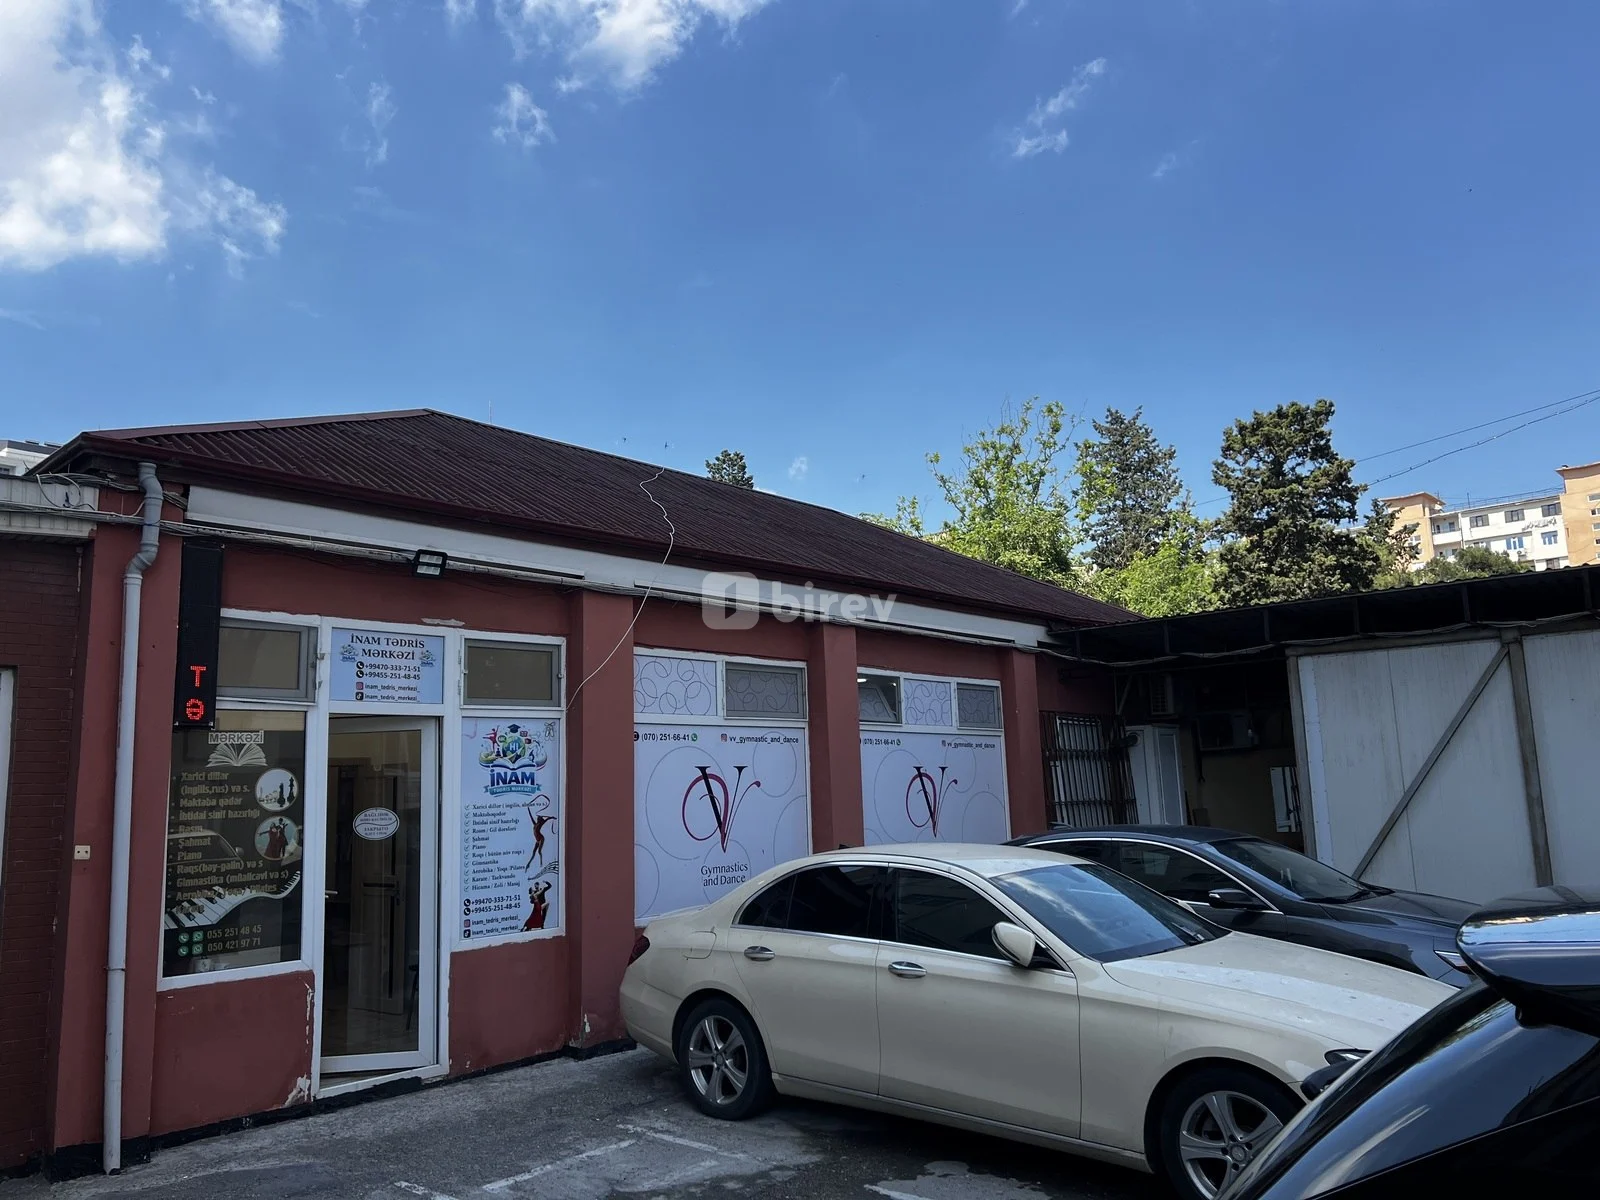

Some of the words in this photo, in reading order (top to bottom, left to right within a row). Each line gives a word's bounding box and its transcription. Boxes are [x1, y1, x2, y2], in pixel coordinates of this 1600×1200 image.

[351, 633, 380, 645] İNAM
[384, 637, 425, 648] TƏDRİS
[361, 648, 415, 660] MƏRKƏZİ
[365, 663, 420, 672] +99470-333-71-51
[364, 672, 420, 680] +99455-251-48-45
[208, 730, 264, 744] MƏRKƏZİ
[641, 733, 659, 742] (070)
[659, 733, 690, 741] 251-66-41
[729, 735, 799, 744] vv_gymnastic_and_dance
[509, 743, 519, 751] HI
[177, 851, 202, 861] Piano
[700, 861, 749, 876] Gymnastics
[176, 875, 224, 887] Gimnastika
[269, 871, 280, 879] və
[703, 874, 718, 887] and
[720, 872, 746, 885] Dance
[471, 894, 521, 906] +99470-333-71-51
[471, 903, 521, 914] +99455-251-48-45
[207, 930, 222, 939] 055
[224, 928, 239, 937] 251
[240, 926, 251, 935] 48
[252, 925, 262, 933] 45
[207, 942, 223, 952] 050
[224, 940, 239, 949] 421
[240, 938, 251, 947] 97
[252, 937, 261, 946] 71
